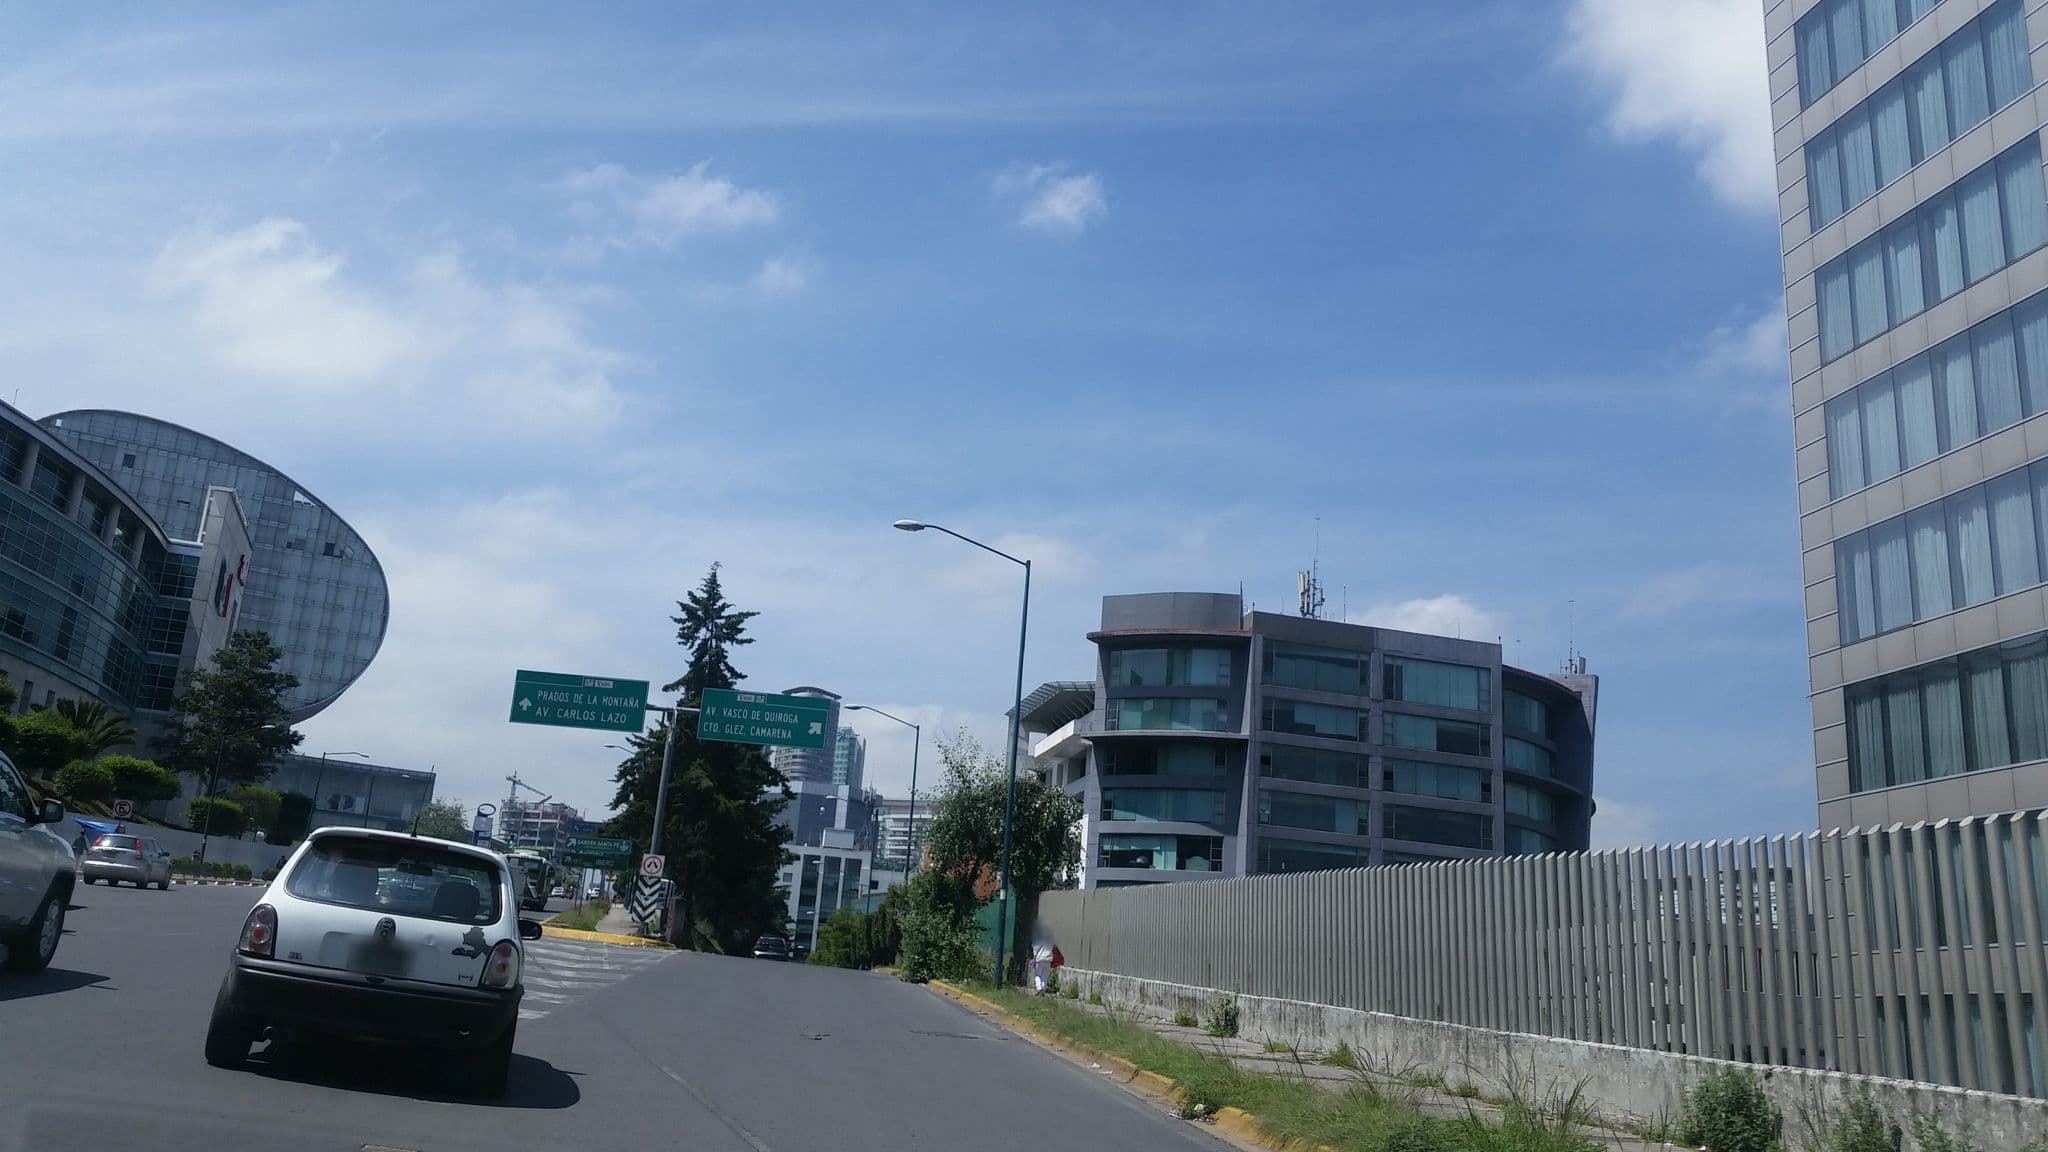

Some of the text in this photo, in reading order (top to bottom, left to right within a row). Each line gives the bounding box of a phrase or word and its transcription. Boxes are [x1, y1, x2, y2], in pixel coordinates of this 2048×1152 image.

[537, 690, 640, 709] PRADOS DE LA MONTAÑA
[557, 708, 596, 721] CARLOS
[601, 711, 627, 724] LAZO
[723, 707, 748, 719] VASCO
[751, 710, 761, 721] DE
[764, 711, 799, 724] QUIROGA
[750, 726, 792, 740] CAMARENA
